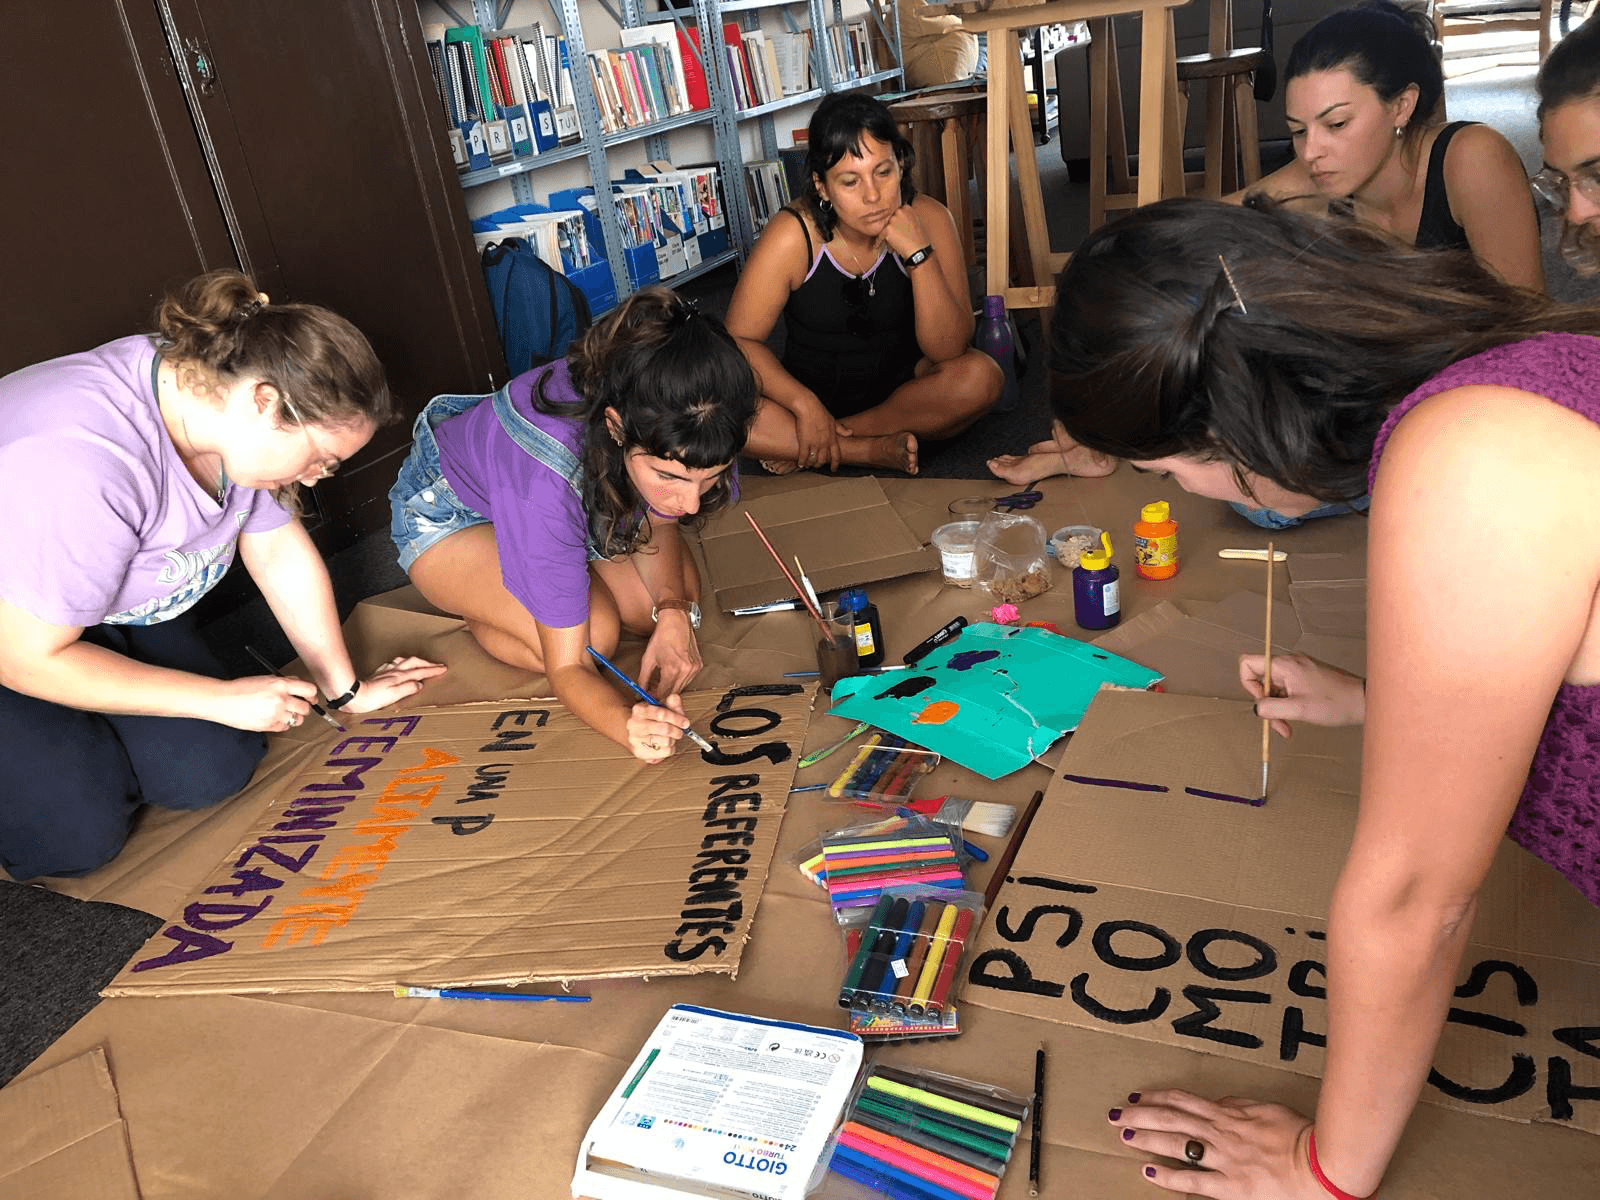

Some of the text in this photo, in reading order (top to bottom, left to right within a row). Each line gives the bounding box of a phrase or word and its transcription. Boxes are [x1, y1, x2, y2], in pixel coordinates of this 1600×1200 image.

[494, 131, 501, 143] R
[516, 123, 523, 135] R
[544, 117, 550, 130] S
[478, 709, 550, 752] EN
[701, 685, 804, 765] LOS
[454, 763, 514, 804] UNA
[130, 715, 423, 972] FEMINIZADA
[260, 747, 460, 949] ALTAMENTE
[664, 773, 762, 962] REFERENTES
[1070, 919, 1182, 1024] CO
[1171, 928, 1278, 1049] MO
[723, 1151, 787, 1175] GIOTTO
[756, 1149, 784, 1159] TURBO
